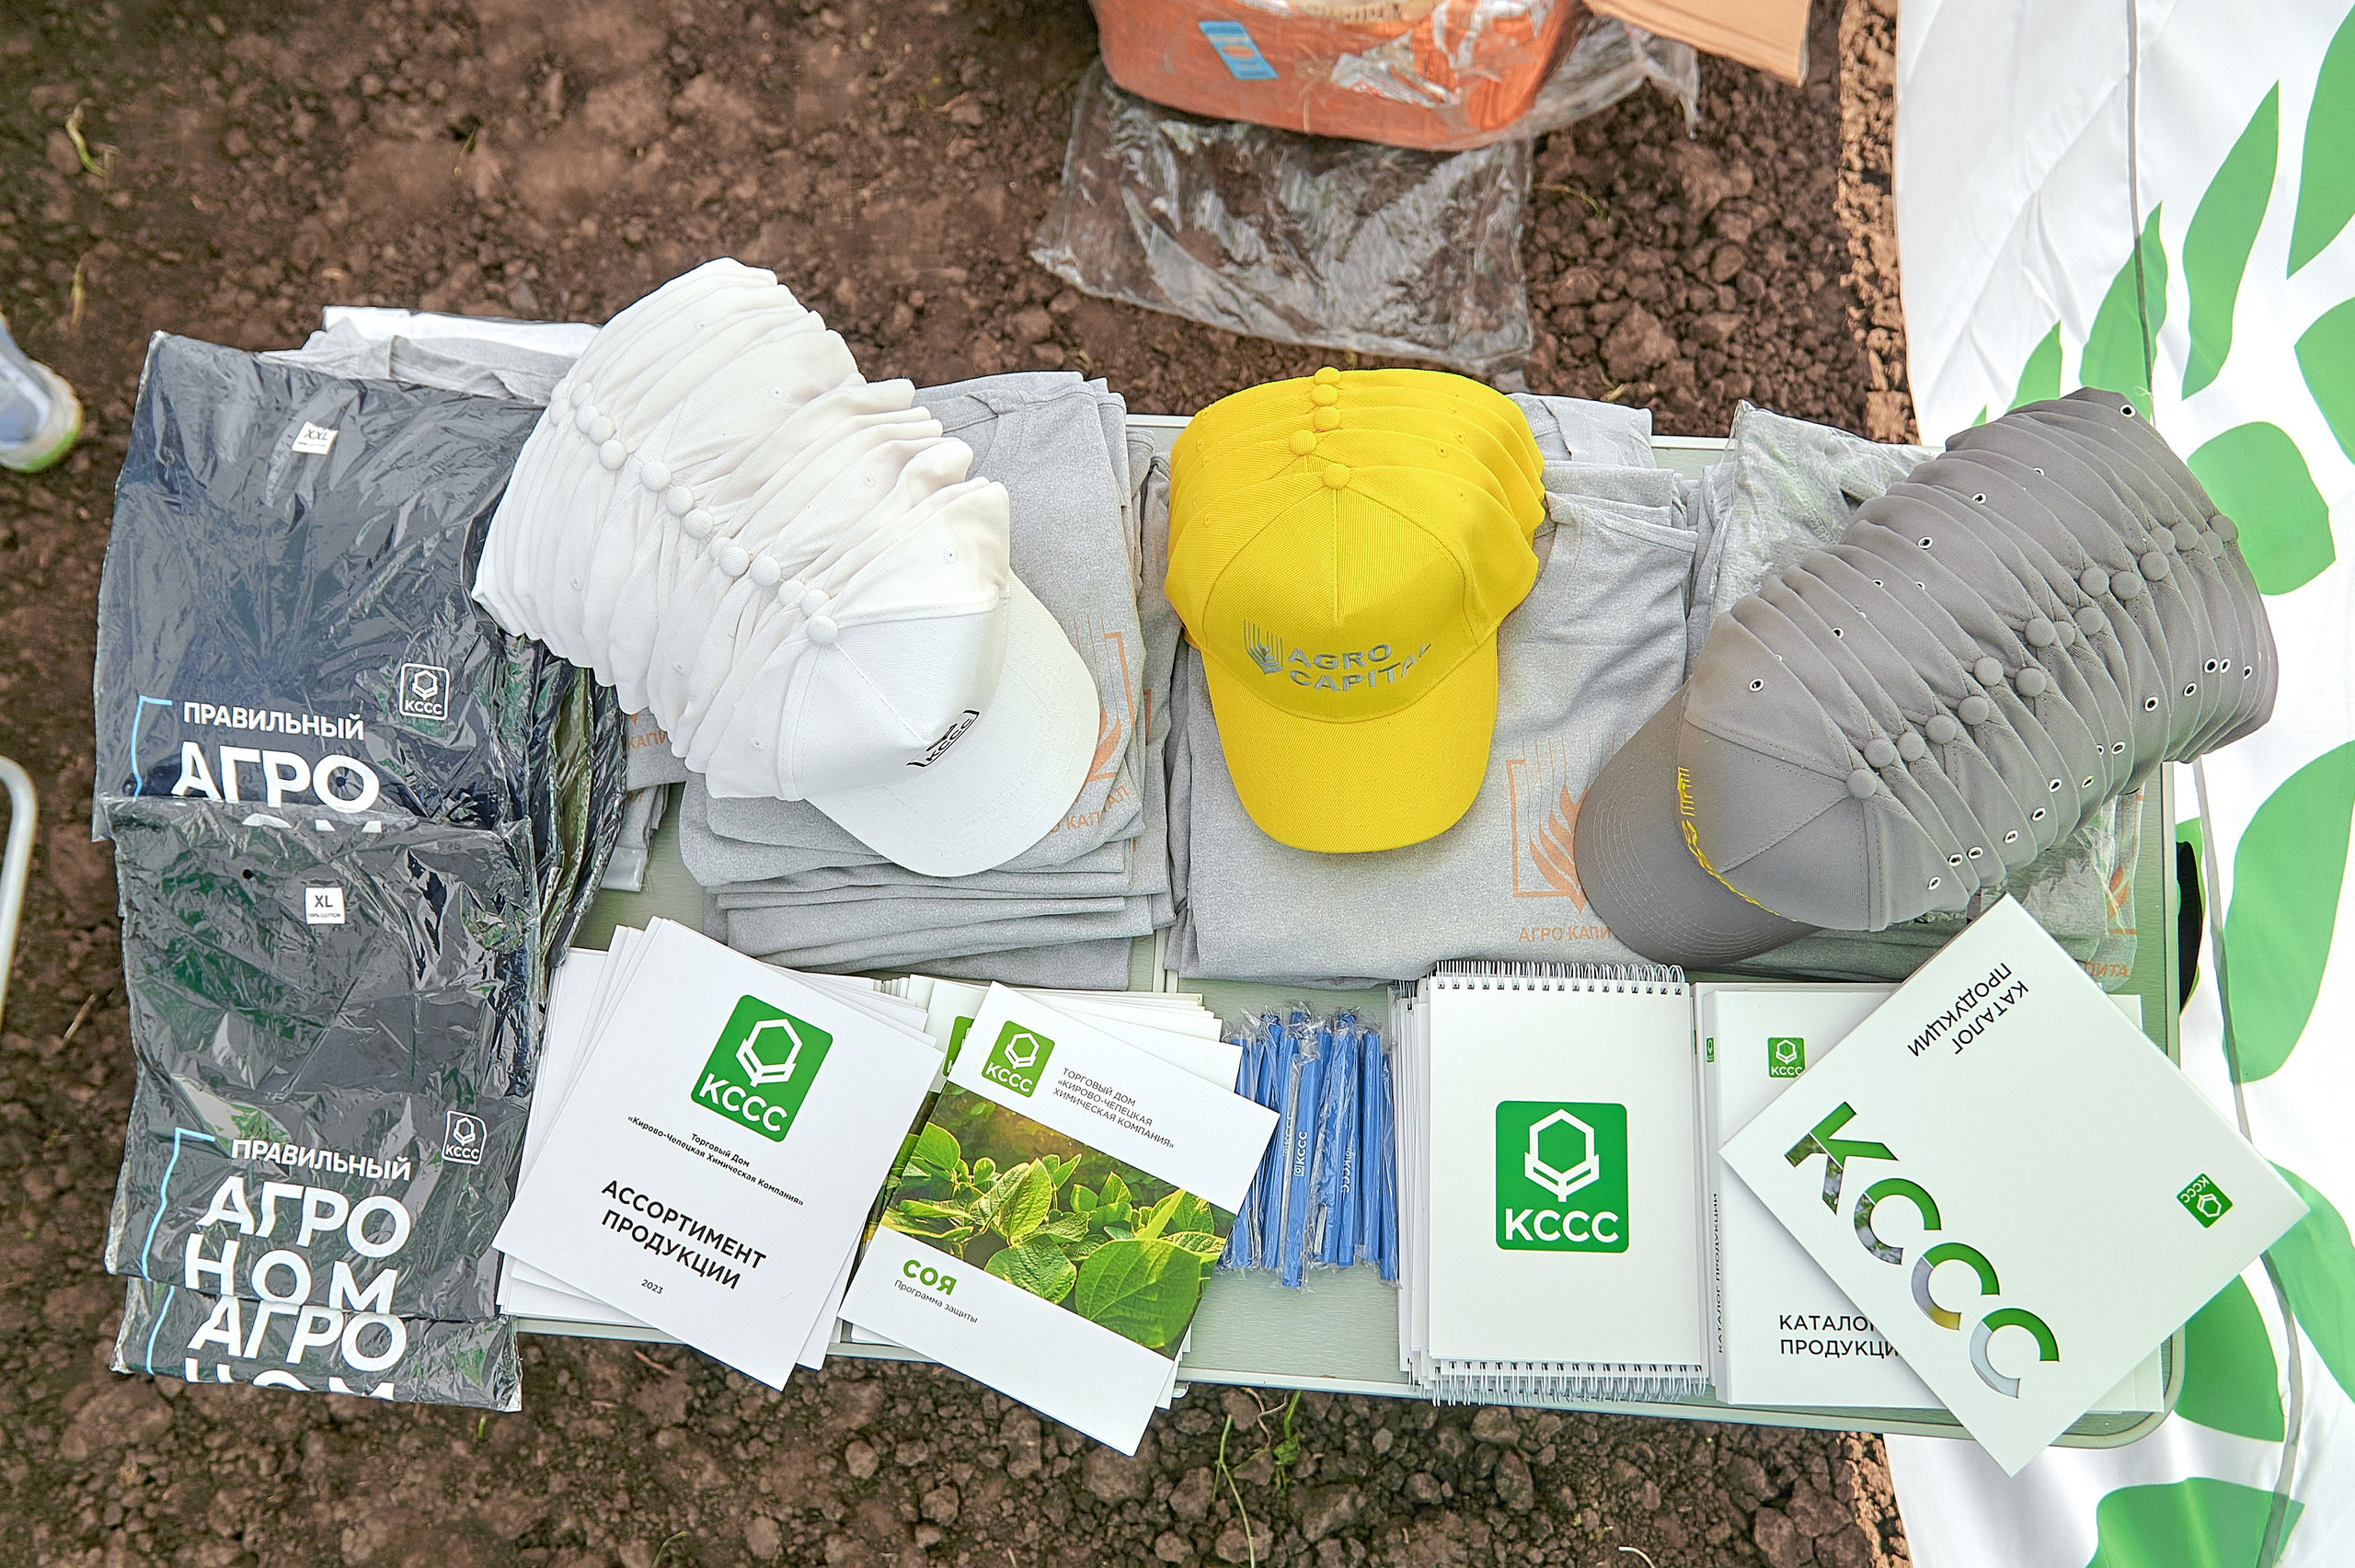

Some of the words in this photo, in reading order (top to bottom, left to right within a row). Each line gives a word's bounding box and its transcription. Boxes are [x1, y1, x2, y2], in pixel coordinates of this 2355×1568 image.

[304, 429, 327, 440] XXL
[1289, 644, 1392, 670] AGRO
[184, 702, 365, 740] ПРАВИЛЬНЫЙ
[405, 700, 442, 715] KCCC
[626, 731, 668, 750] КАПИ
[171, 740, 380, 813] АГРО
[315, 895, 333, 908] XL
[1518, 926, 1563, 942] АГРО
[1568, 925, 1612, 941] КАПИ
[1907, 962, 2012, 1057] ПРОДУКЦИИ
[1951, 980, 2028, 1055] КАТАЛОГ
[985, 1061, 1033, 1093] KCCC
[1063, 1067, 1113, 1096] ТОРГОВЫЙ
[1112, 1092, 1136, 1106] ДОМ
[1771, 1066, 1803, 1076] KCCC
[698, 1072, 787, 1132] KCCC
[1052, 1088, 1117, 1122] ХИМИЧЕСКАЯ
[1117, 1116, 1174, 1149] КОМПАНИЯ»
[1057, 1079, 1153, 1127] «КИРОВО-ЧЕПЕЦКАЯ
[231, 1139, 411, 1181] ПРАВИЛЬНЫЙ
[445, 1144, 480, 1161] KCCC
[627, 1116, 706, 1159] «Кирово-Чепецкая
[706, 1152, 756, 1184] Химическая
[757, 1178, 804, 1206] Компания»
[691, 1133, 730, 1158] Торговый
[731, 1153, 751, 1168] Дом
[1296, 1130, 1307, 1164] KCCC
[2180, 1176, 2210, 1204] KCCC
[195, 1175, 411, 1258] АГРО
[601, 1180, 767, 1269] АССОРТИМЕНТ
[1505, 1207, 1620, 1243] KCCC
[602, 1209, 741, 1289] ПРОДУКЦИИ
[1783, 1101, 2060, 1400] KCCC
[184, 1232, 398, 1314] НОМ
[641, 1278, 664, 1295] 2023
[902, 1259, 957, 1296] СОЯ
[894, 1279, 943, 1308] Программа
[944, 1303, 978, 1324] защиты
[187, 1295, 407, 1372] АГРО
[1780, 1339, 1899, 1359] ПРОДУКЦИ
